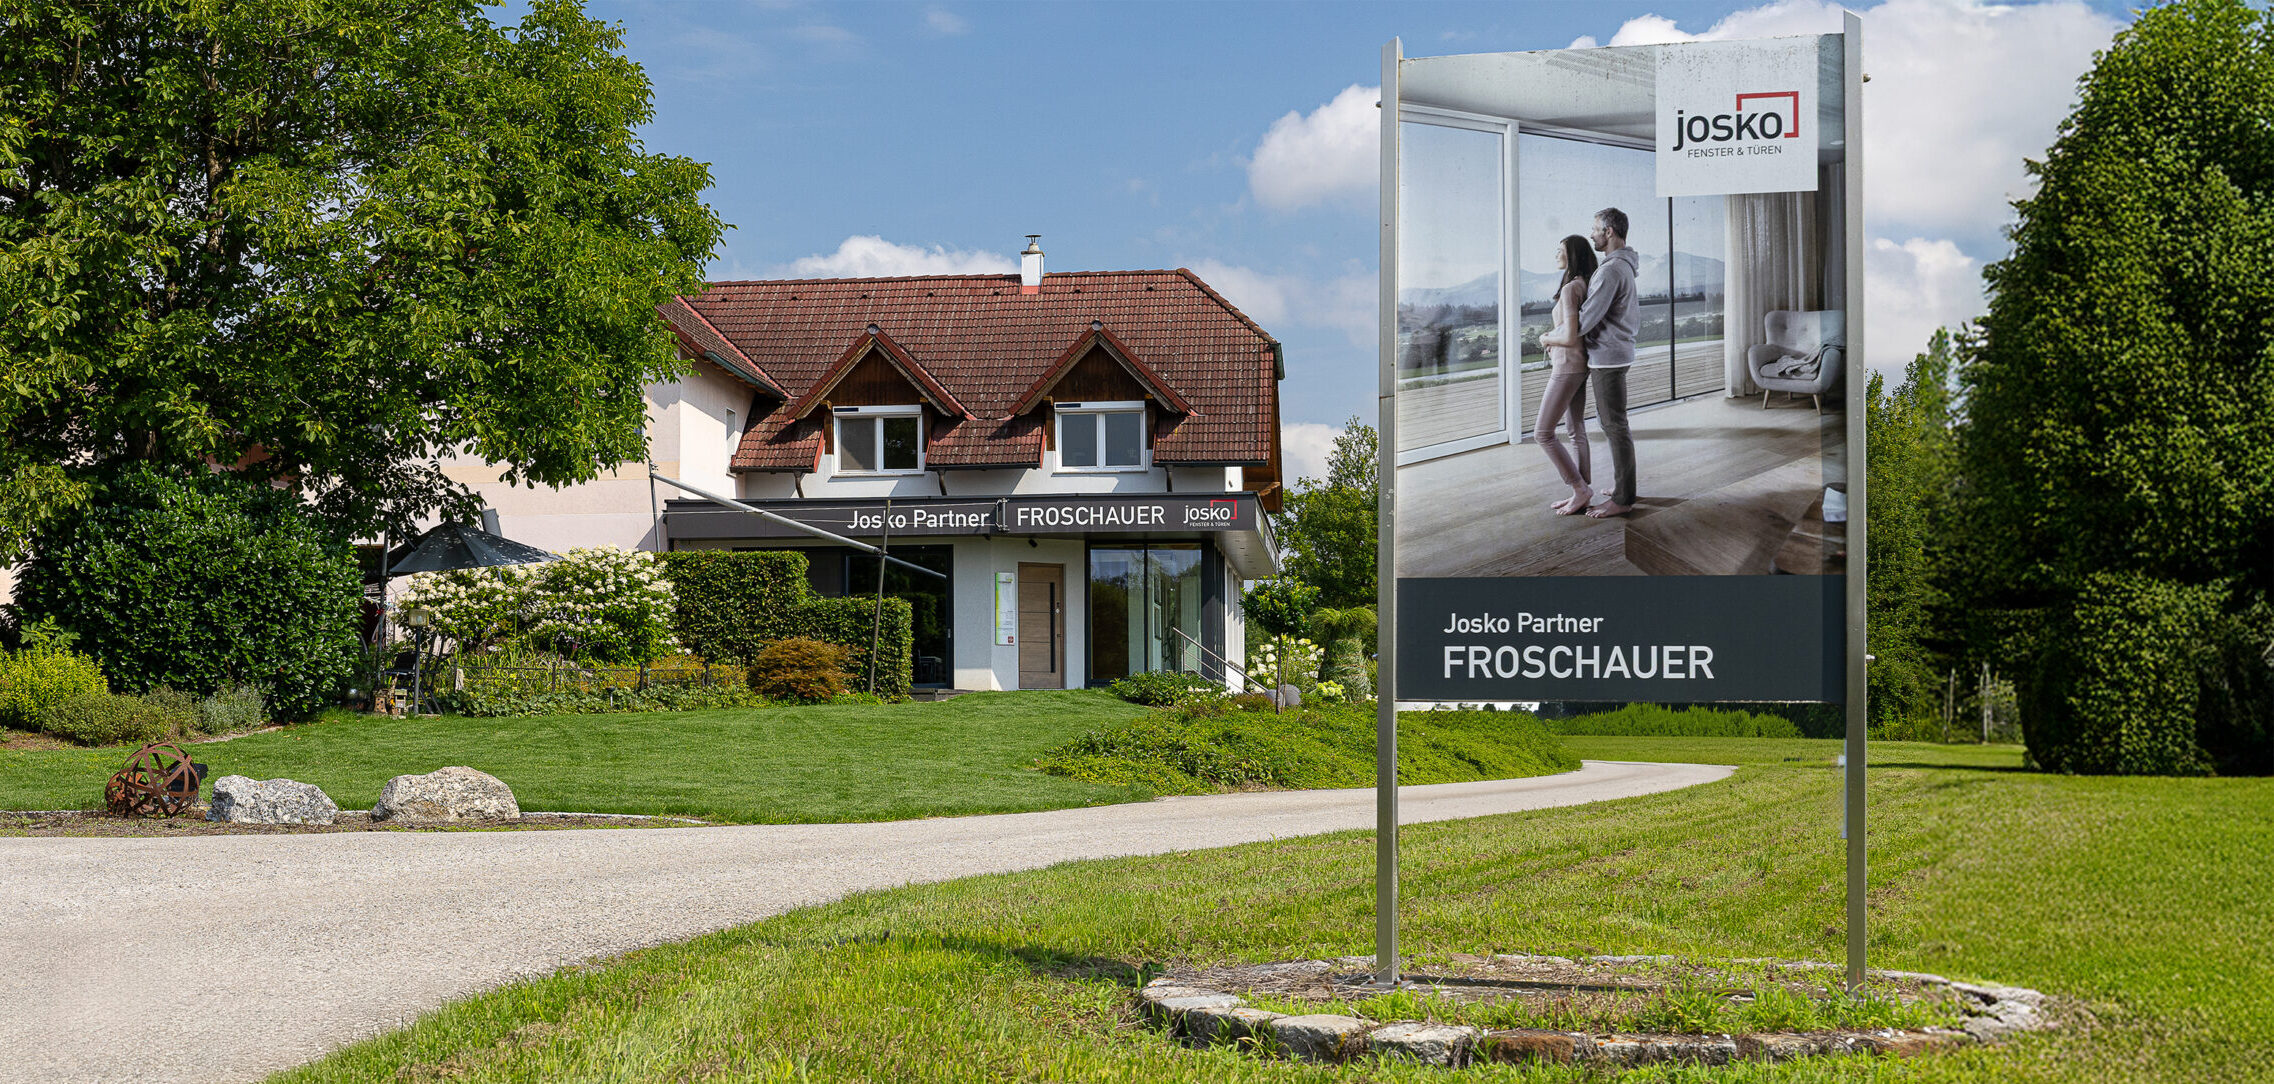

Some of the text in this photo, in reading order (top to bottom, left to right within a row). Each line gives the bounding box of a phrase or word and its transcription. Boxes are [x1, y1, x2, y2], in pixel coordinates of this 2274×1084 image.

[1672, 109, 1782, 151] josko
[1687, 144, 1782, 158] FENSTER & TÜREN
[913, 509, 990, 528] Partner
[1017, 505, 1165, 526] FROSCHAUER
[1183, 505, 1230, 524] josko
[1443, 612, 1604, 633] Josko Partner
[1444, 645, 1715, 679] FROSCHAUER
